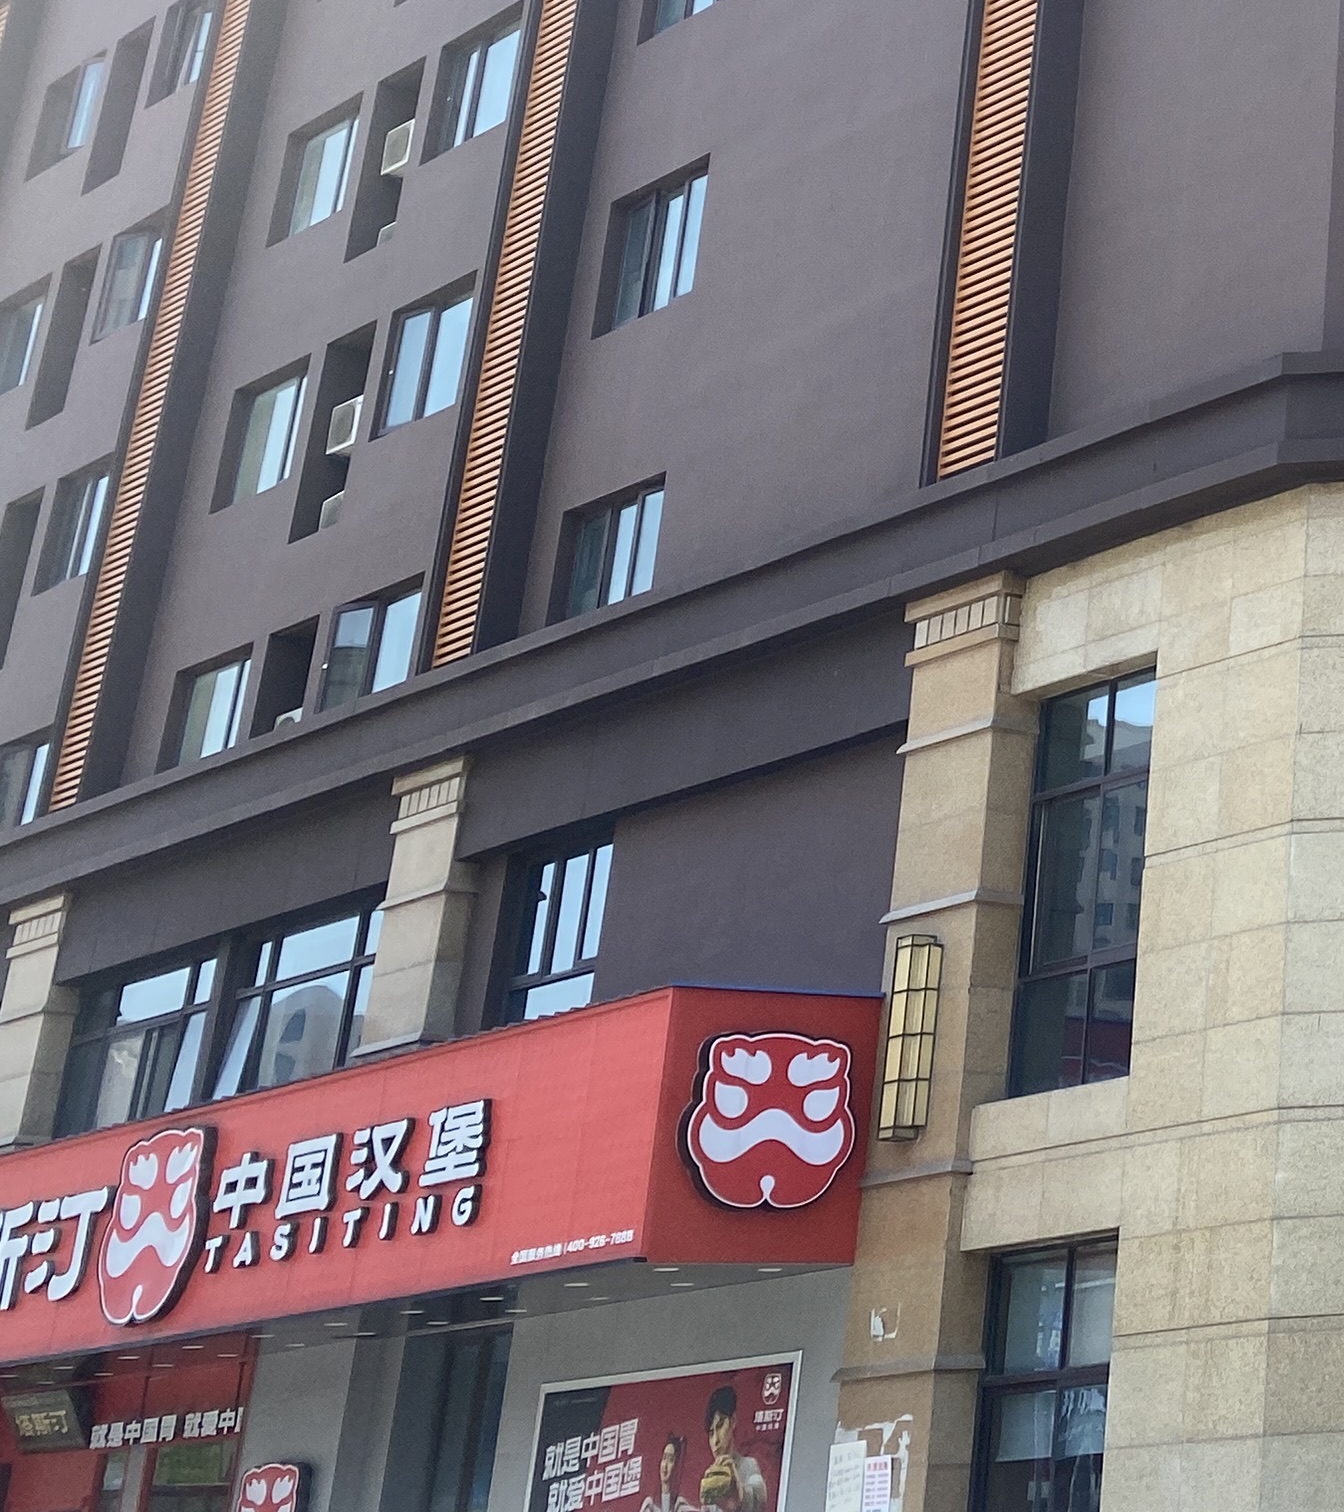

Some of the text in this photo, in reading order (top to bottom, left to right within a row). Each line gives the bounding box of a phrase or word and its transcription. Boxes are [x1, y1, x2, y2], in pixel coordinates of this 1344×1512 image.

[212, 1099, 489, 1230] 中国汉堡
[204, 1184, 481, 1274] TASITING
[542, 1418, 639, 1482] 就是中国胃
[545, 1455, 643, 1512] 就爱中国堡
